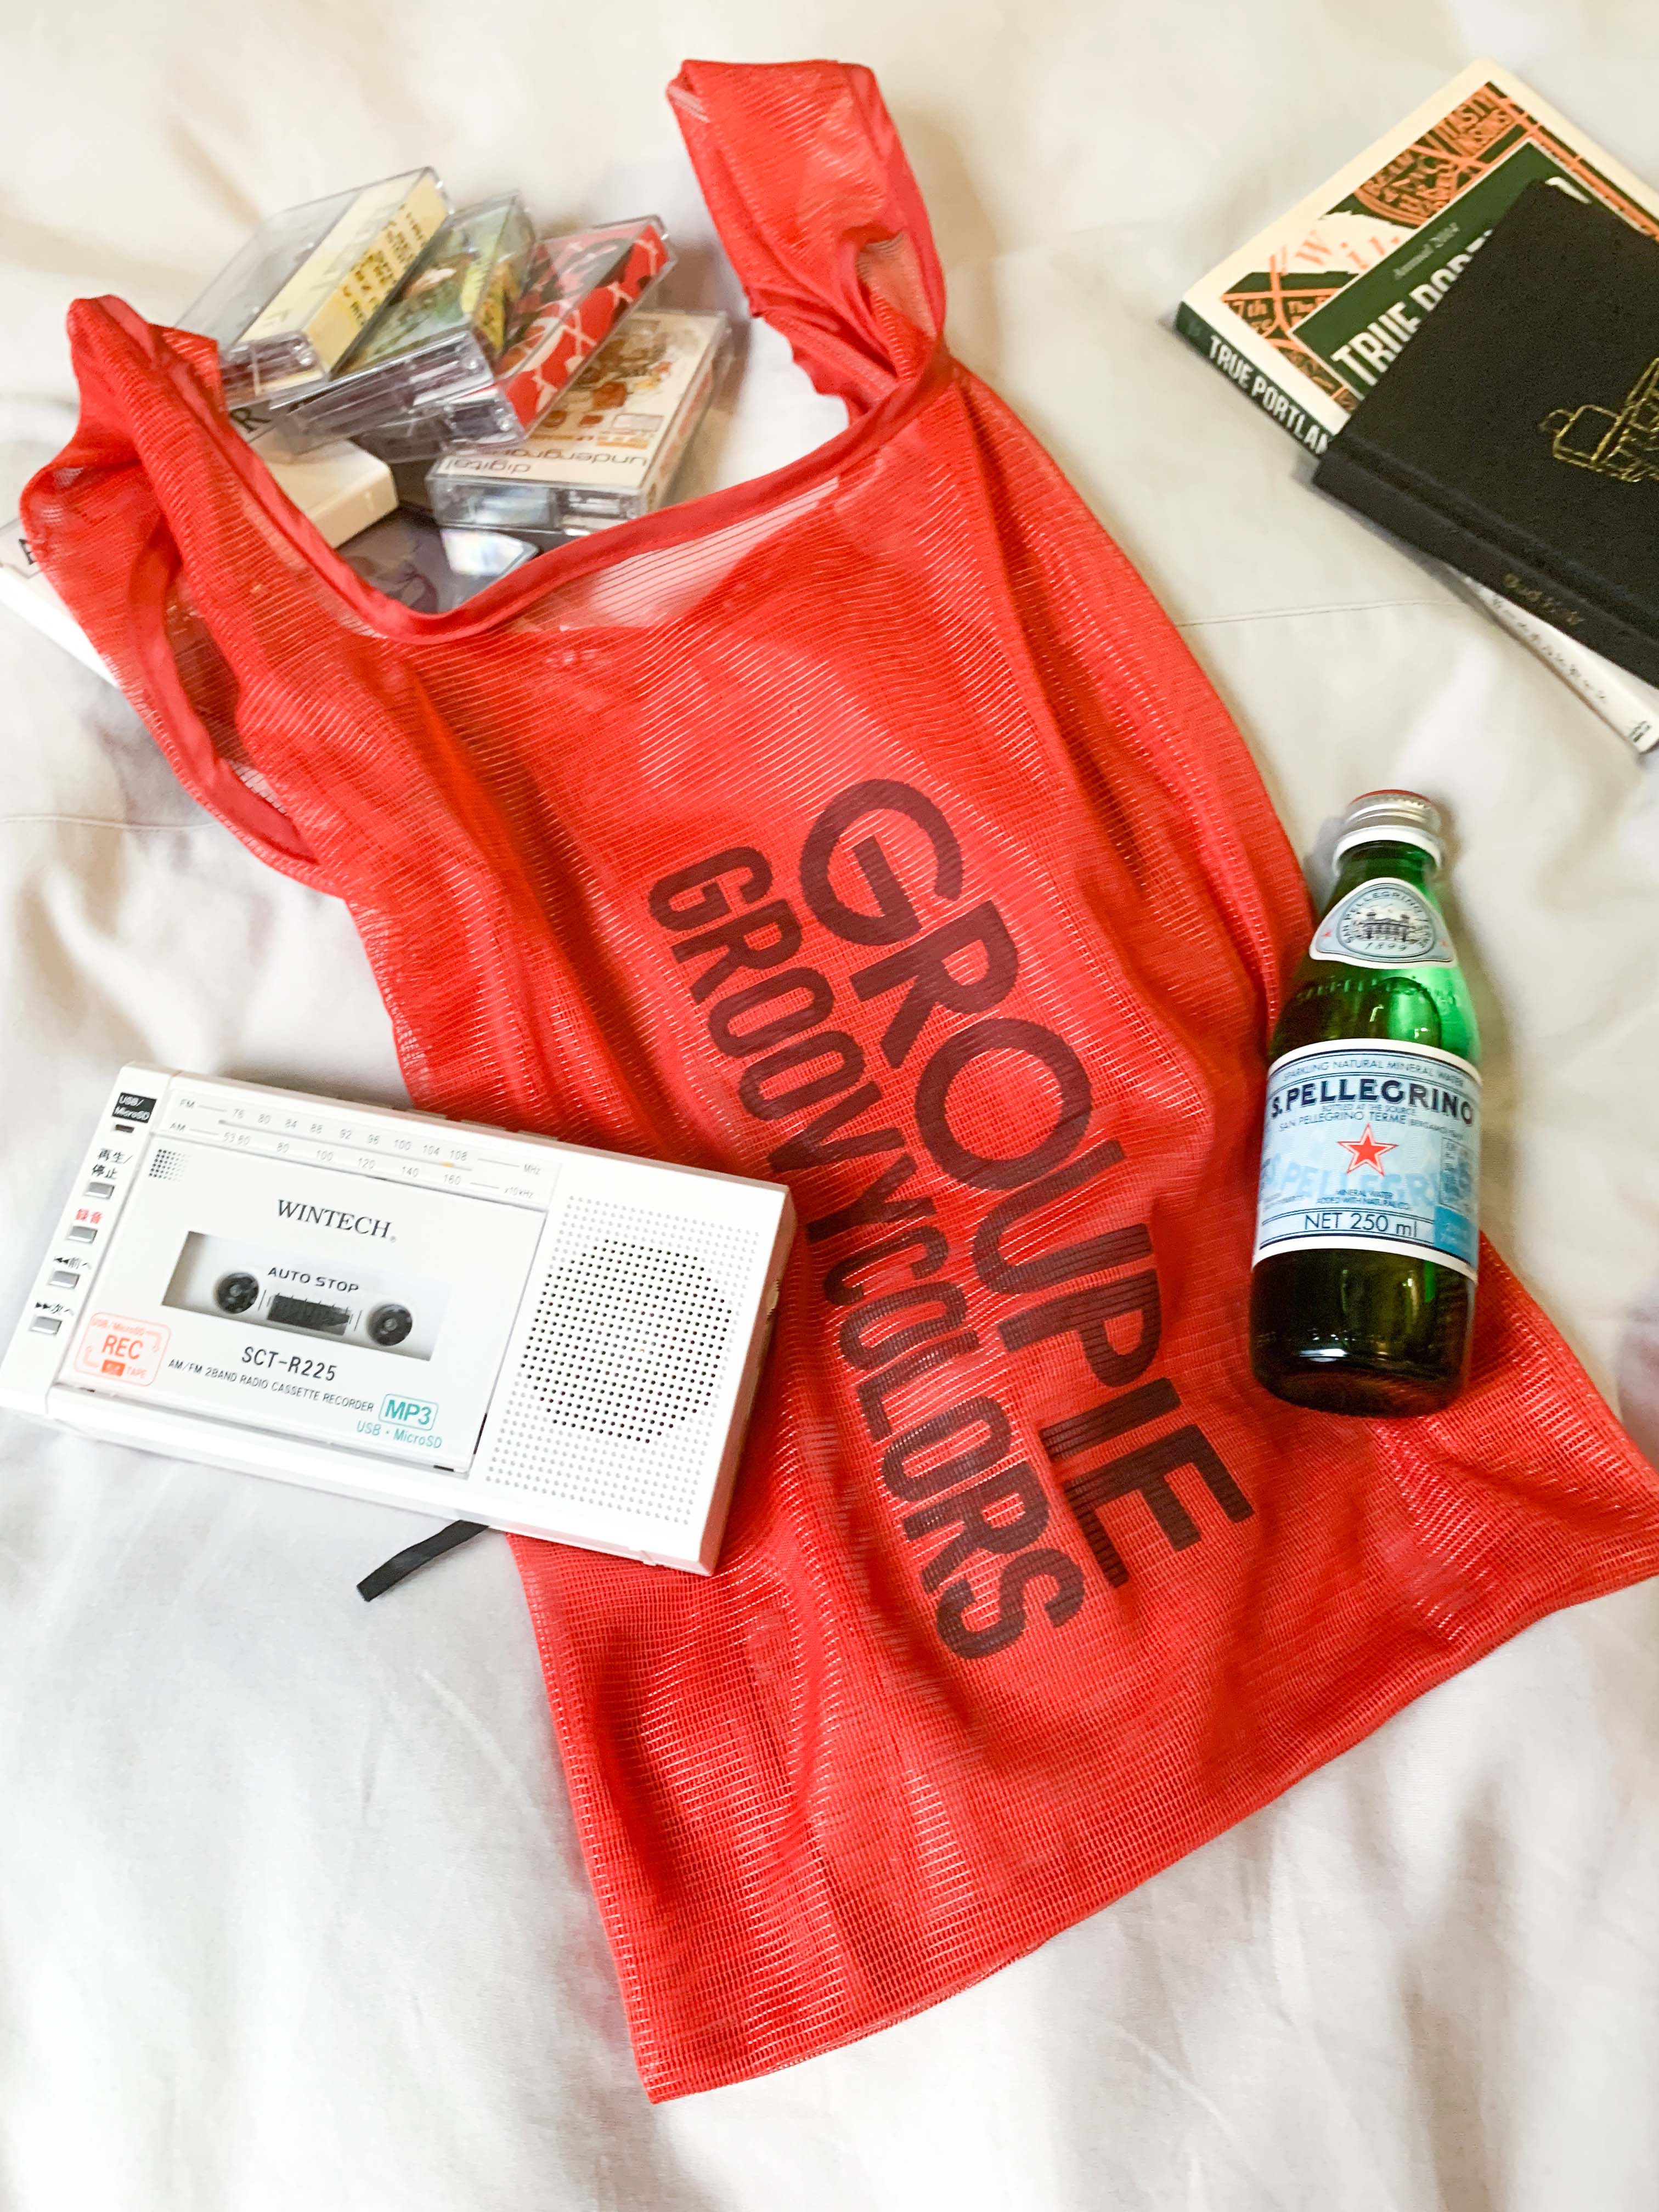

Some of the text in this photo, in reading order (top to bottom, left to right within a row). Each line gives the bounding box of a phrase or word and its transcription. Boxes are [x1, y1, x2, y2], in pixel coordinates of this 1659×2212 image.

[1330, 302, 1421, 386] TRUE
[1210, 335, 1254, 388] TRUE
[446, 459, 532, 475] digital
[1333, 1059, 1385, 1070] NATURAL
[1387, 1061, 1434, 1077] MINERAL
[1279, 1121, 1296, 1132] SAN
[1299, 1111, 1365, 1125] PELLEGRINO
[1369, 1111, 1407, 1124] TERME
[169, 1122, 187, 1132] AM
[317, 1150, 334, 1162] 100
[358, 1158, 375, 1170] 120
[402, 1166, 420, 1178] 140
[179, 1098, 196, 1109] FM
[257, 1113, 272, 1124] 80
[285, 1118, 298, 1129] 84
[394, 1139, 411, 1152] 100
[423, 1144, 440, 1156] 104
[450, 1149, 468, 1161] 108
[523, 1163, 541, 1176] MHz
[92, 1164, 117, 1179] 停止
[799, 779, 1253, 1588] GROUPIE
[278, 1199, 392, 1239] WINTECH
[1305, 1212, 1417, 1238] NET 250 ml
[267, 1267, 360, 1293] AUTO STOP
[101, 1334, 143, 1361] REC
[241, 1346, 338, 1382] SCT-R225
[168, 1358, 374, 1413] AM/FM 2BAND RADIO CASSETTE RECORDER
[384, 1400, 433, 1426] MP3
[356, 1420, 444, 1449] USB MicroSD
